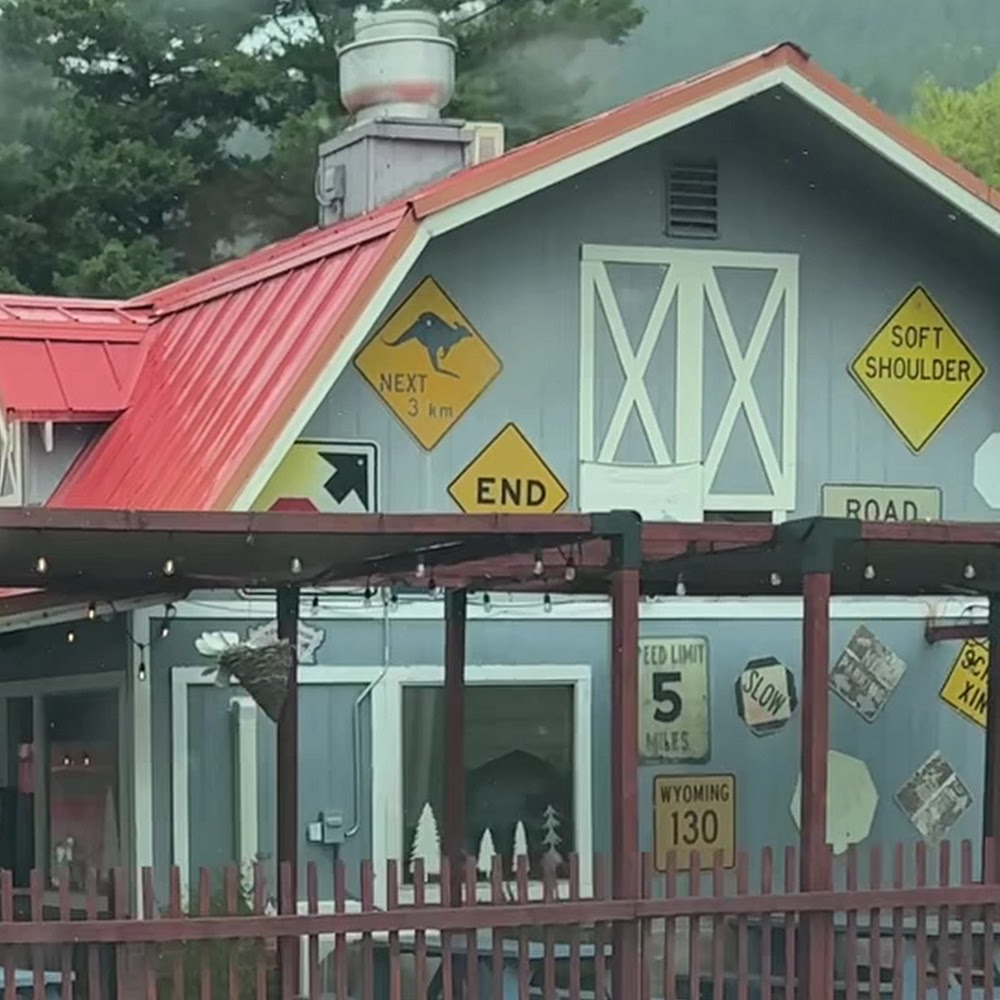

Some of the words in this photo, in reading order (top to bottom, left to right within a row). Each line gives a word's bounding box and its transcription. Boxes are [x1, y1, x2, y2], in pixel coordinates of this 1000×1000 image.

[891, 325, 943, 349] SOFT
[865, 356, 971, 381] SHOULDER
[379, 373, 428, 394] NEXT
[407, 398, 419, 418] 3
[429, 403, 454, 418] km
[477, 477, 547, 507] END
[846, 499, 918, 522] ROAD
[638, 645, 668, 666] EED
[671, 644, 704, 664] LIMIT
[652, 671, 682, 723] 5
[743, 669, 787, 716] SLOW
[645, 731, 689, 752] MILES
[660, 784, 729, 803] WYOMING
[671, 809, 718, 846] 130
